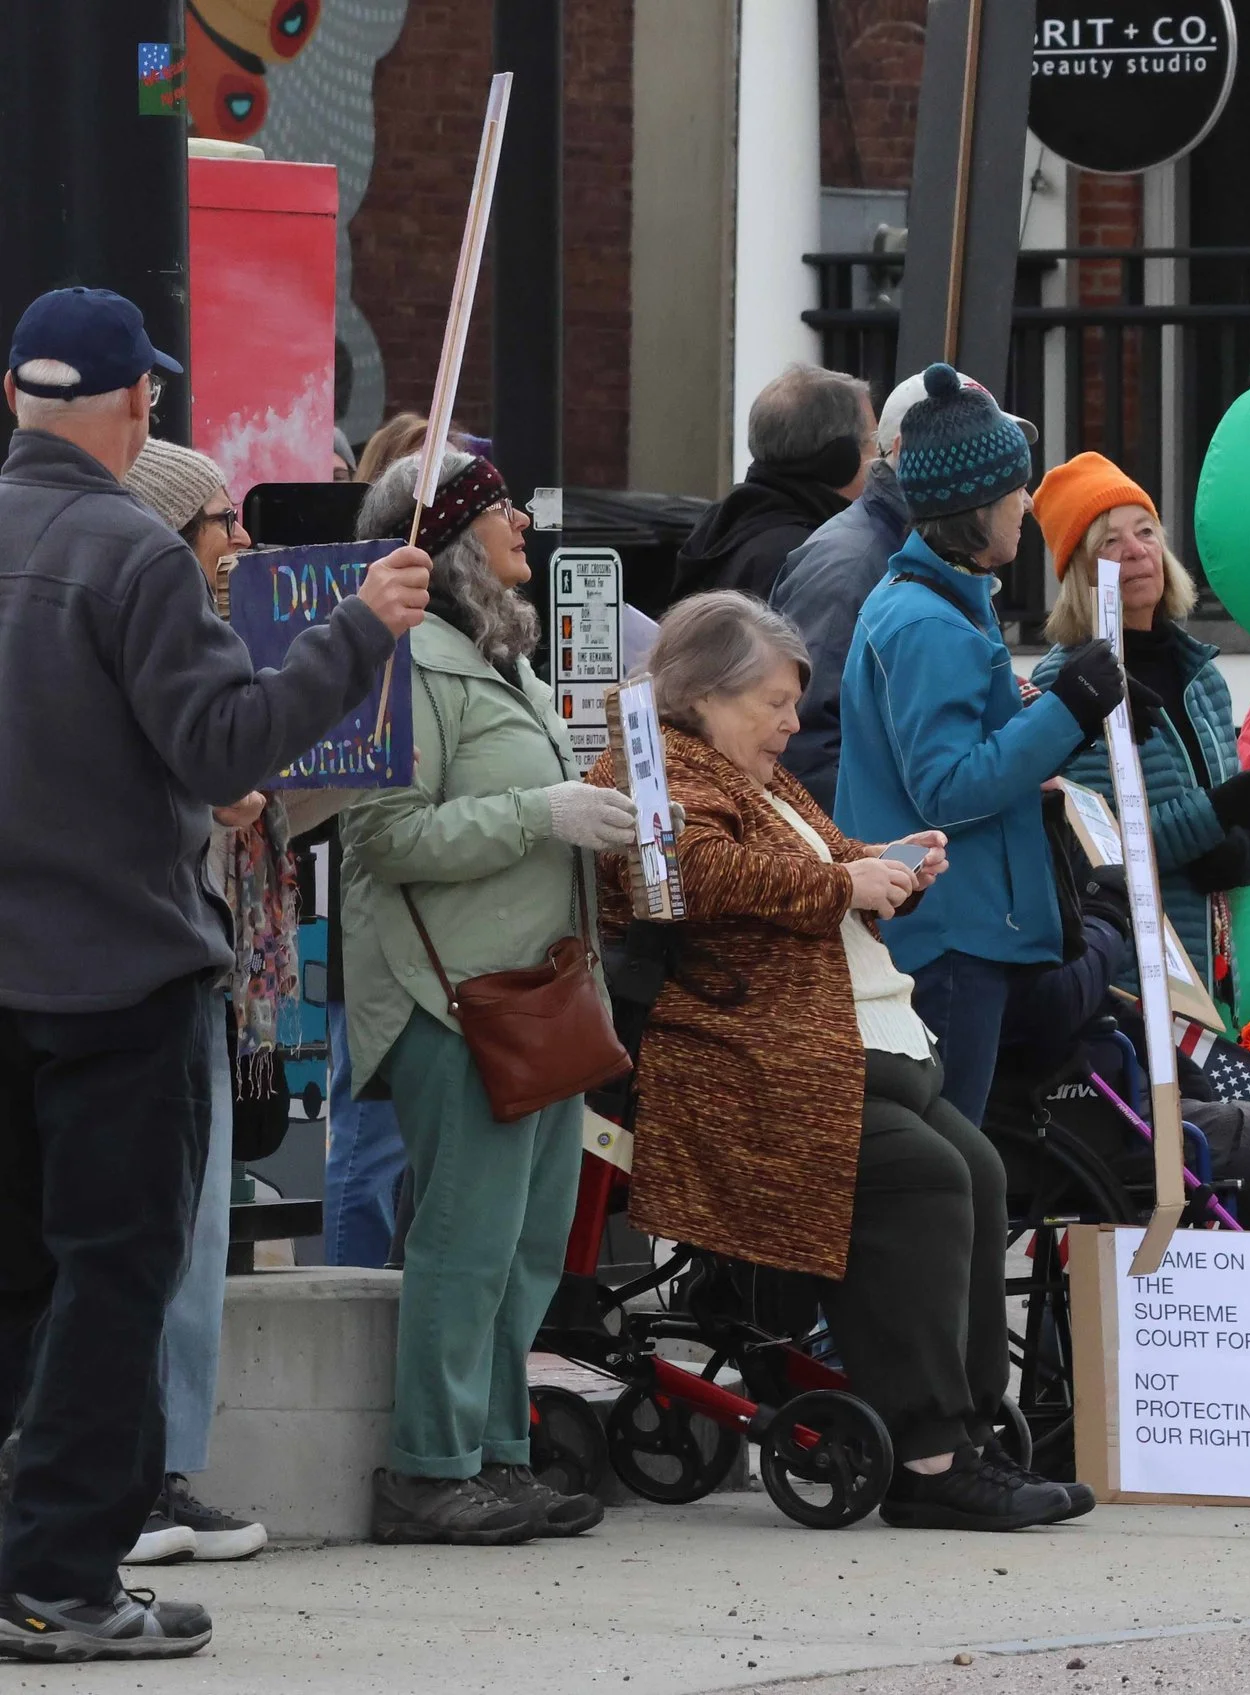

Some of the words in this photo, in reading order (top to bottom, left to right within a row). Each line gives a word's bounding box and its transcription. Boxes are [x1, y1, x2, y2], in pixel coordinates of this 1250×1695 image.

[1034, 19, 1114, 47] RIT
[1153, 16, 1217, 45] CO.
[1127, 54, 1207, 73] studio
[586, 734, 607, 745] BUTTON
[1133, 1250, 1207, 1269] AME
[1214, 1252, 1245, 1270] ON
[1133, 1276, 1174, 1295] THE
[1134, 1303, 1238, 1323] SUPREME
[1135, 1329, 1209, 1348] COURT
[1135, 1373, 1179, 1391] NOT
[1136, 1427, 1182, 1445] OUR
